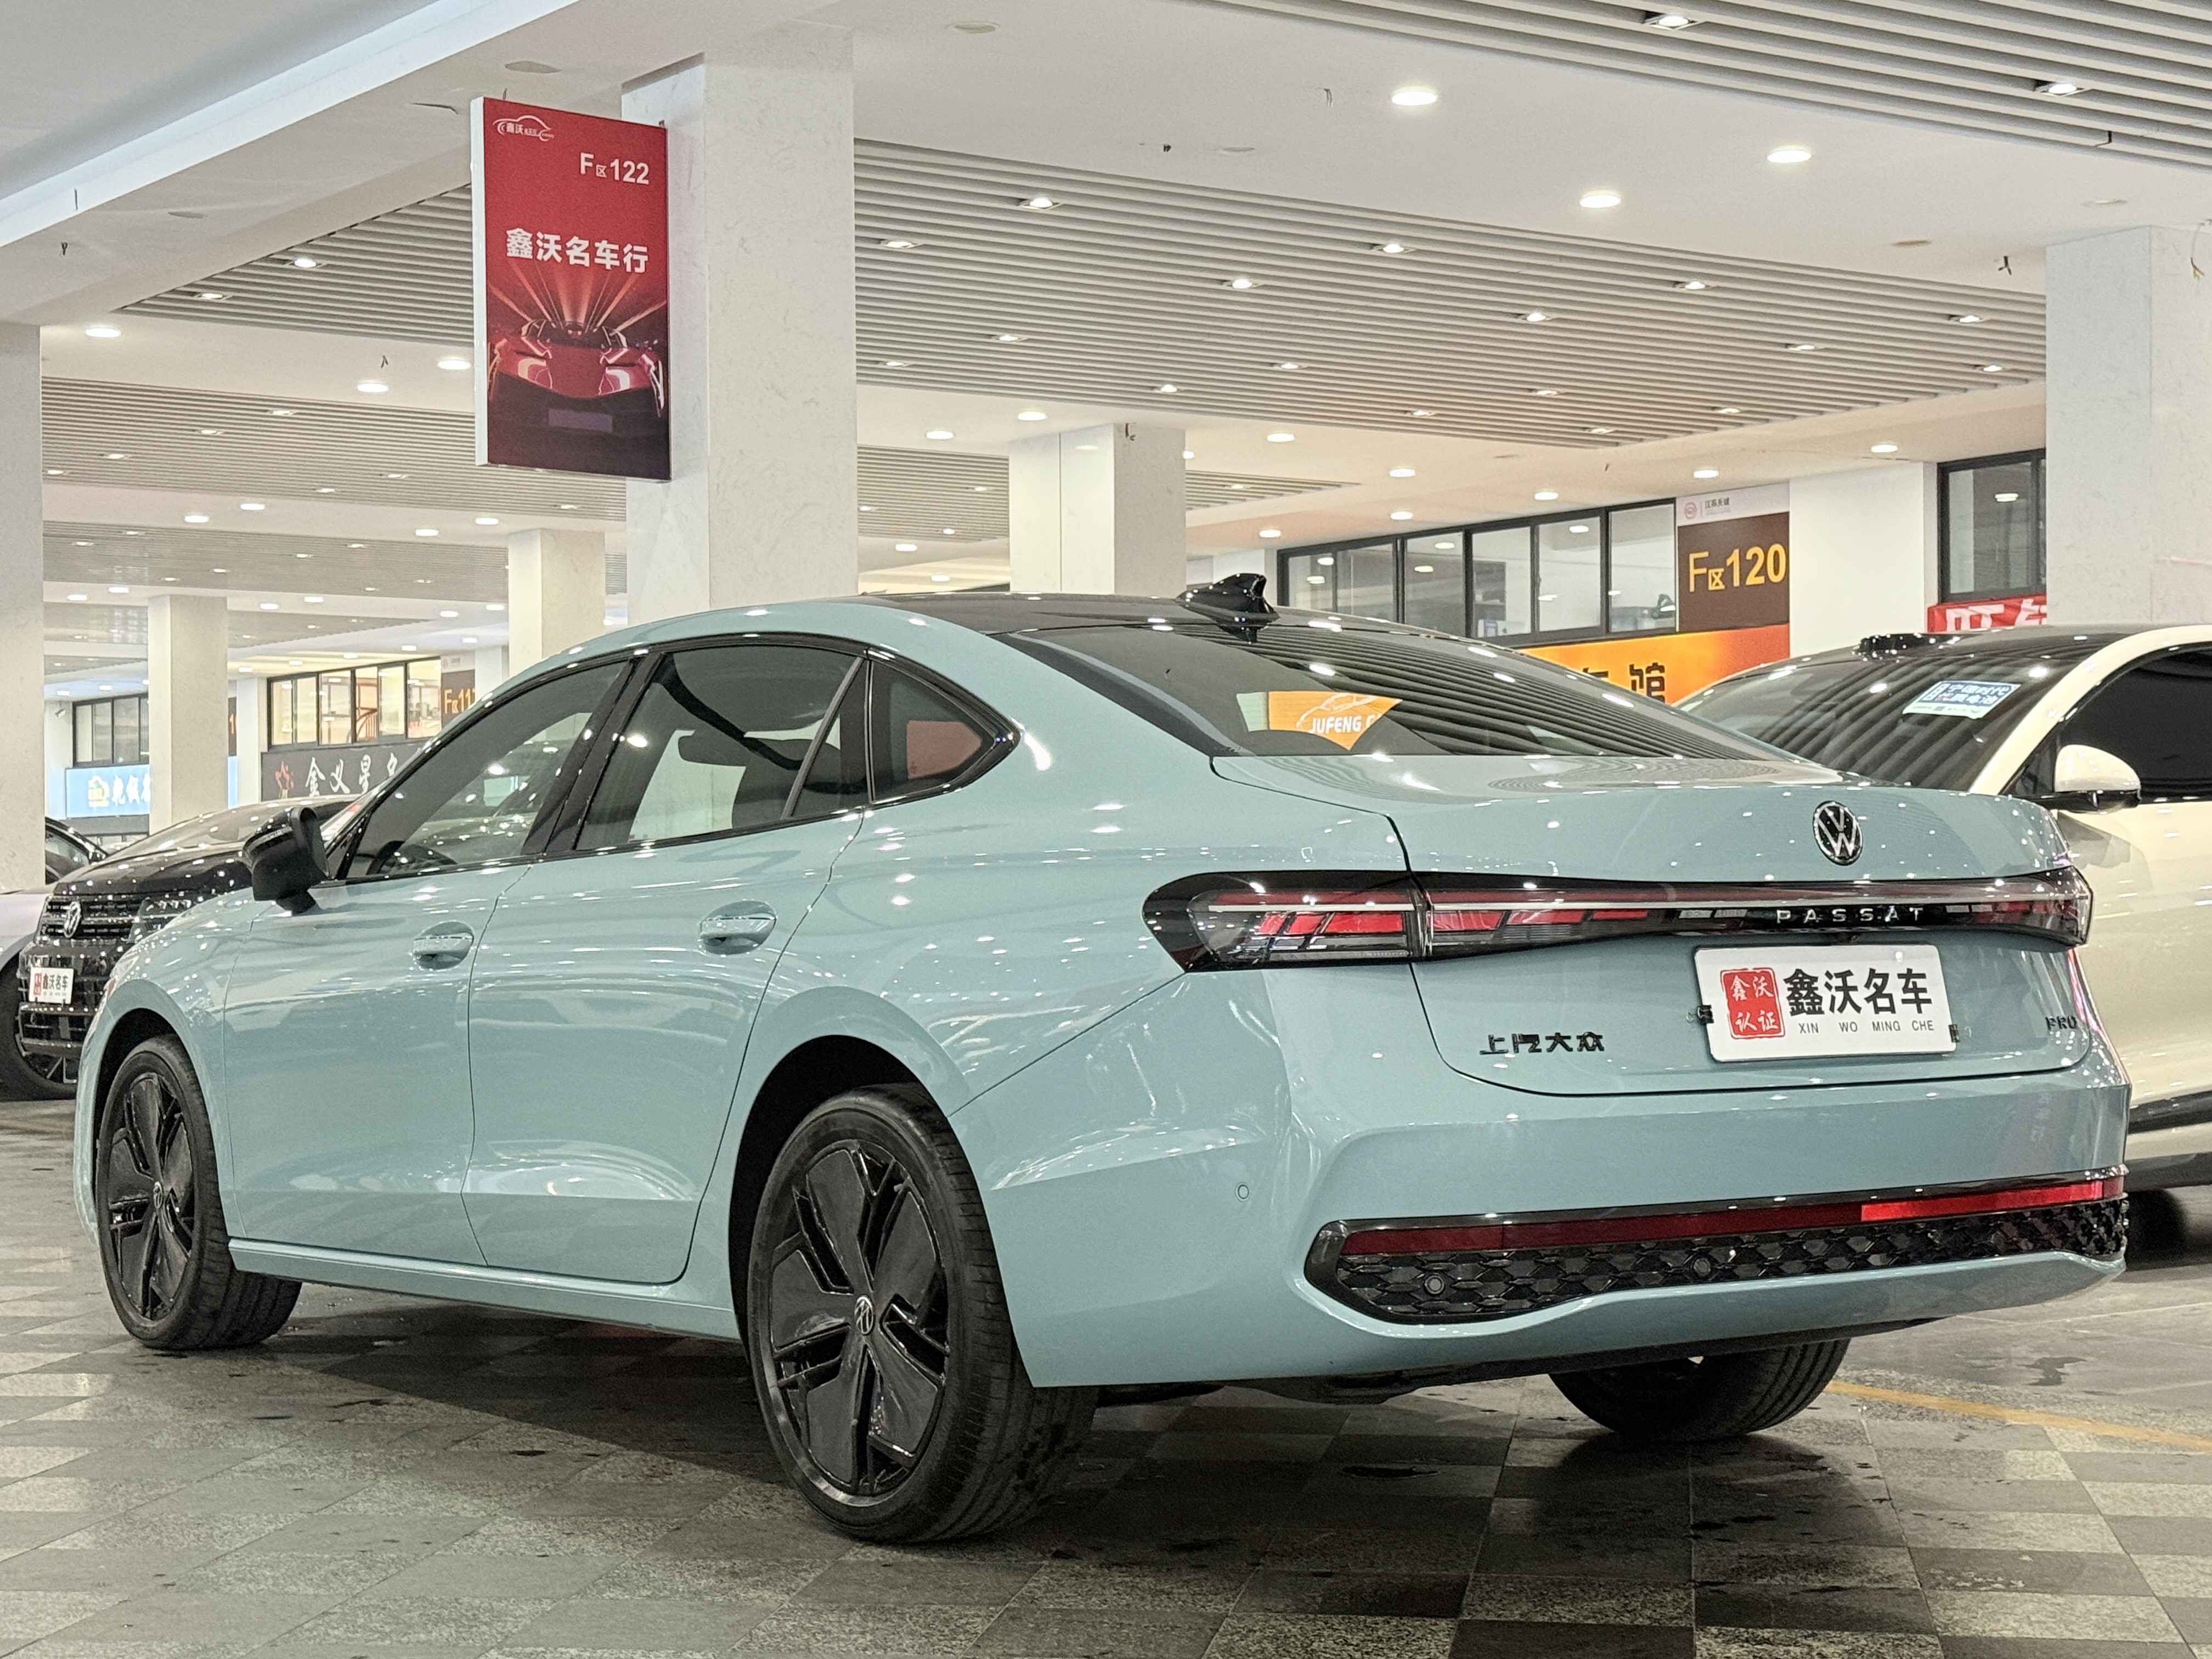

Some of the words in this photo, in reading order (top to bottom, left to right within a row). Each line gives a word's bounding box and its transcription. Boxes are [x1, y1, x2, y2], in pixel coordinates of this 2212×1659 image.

[580, 152, 650, 185] F区122
[506, 228, 648, 274] 鑫沃名车行
[1689, 543, 1786, 592] F区120
[444, 688, 475, 714] F区11
[1310, 717, 1362, 734] JUFENG
[1776, 906, 1924, 924] PASSAT
[1730, 975, 1774, 1002] 鑫沃
[1783, 968, 1933, 1017] 鑫沃名车
[1735, 1009, 1779, 1032] 认证
[1798, 1022, 1820, 1034] XIN
[1838, 1021, 1858, 1032] WO
[1872, 1020, 1901, 1032] MING
[1911, 1020, 1935, 1031] CHE
[1480, 1031, 1605, 1055] 上汽大众
